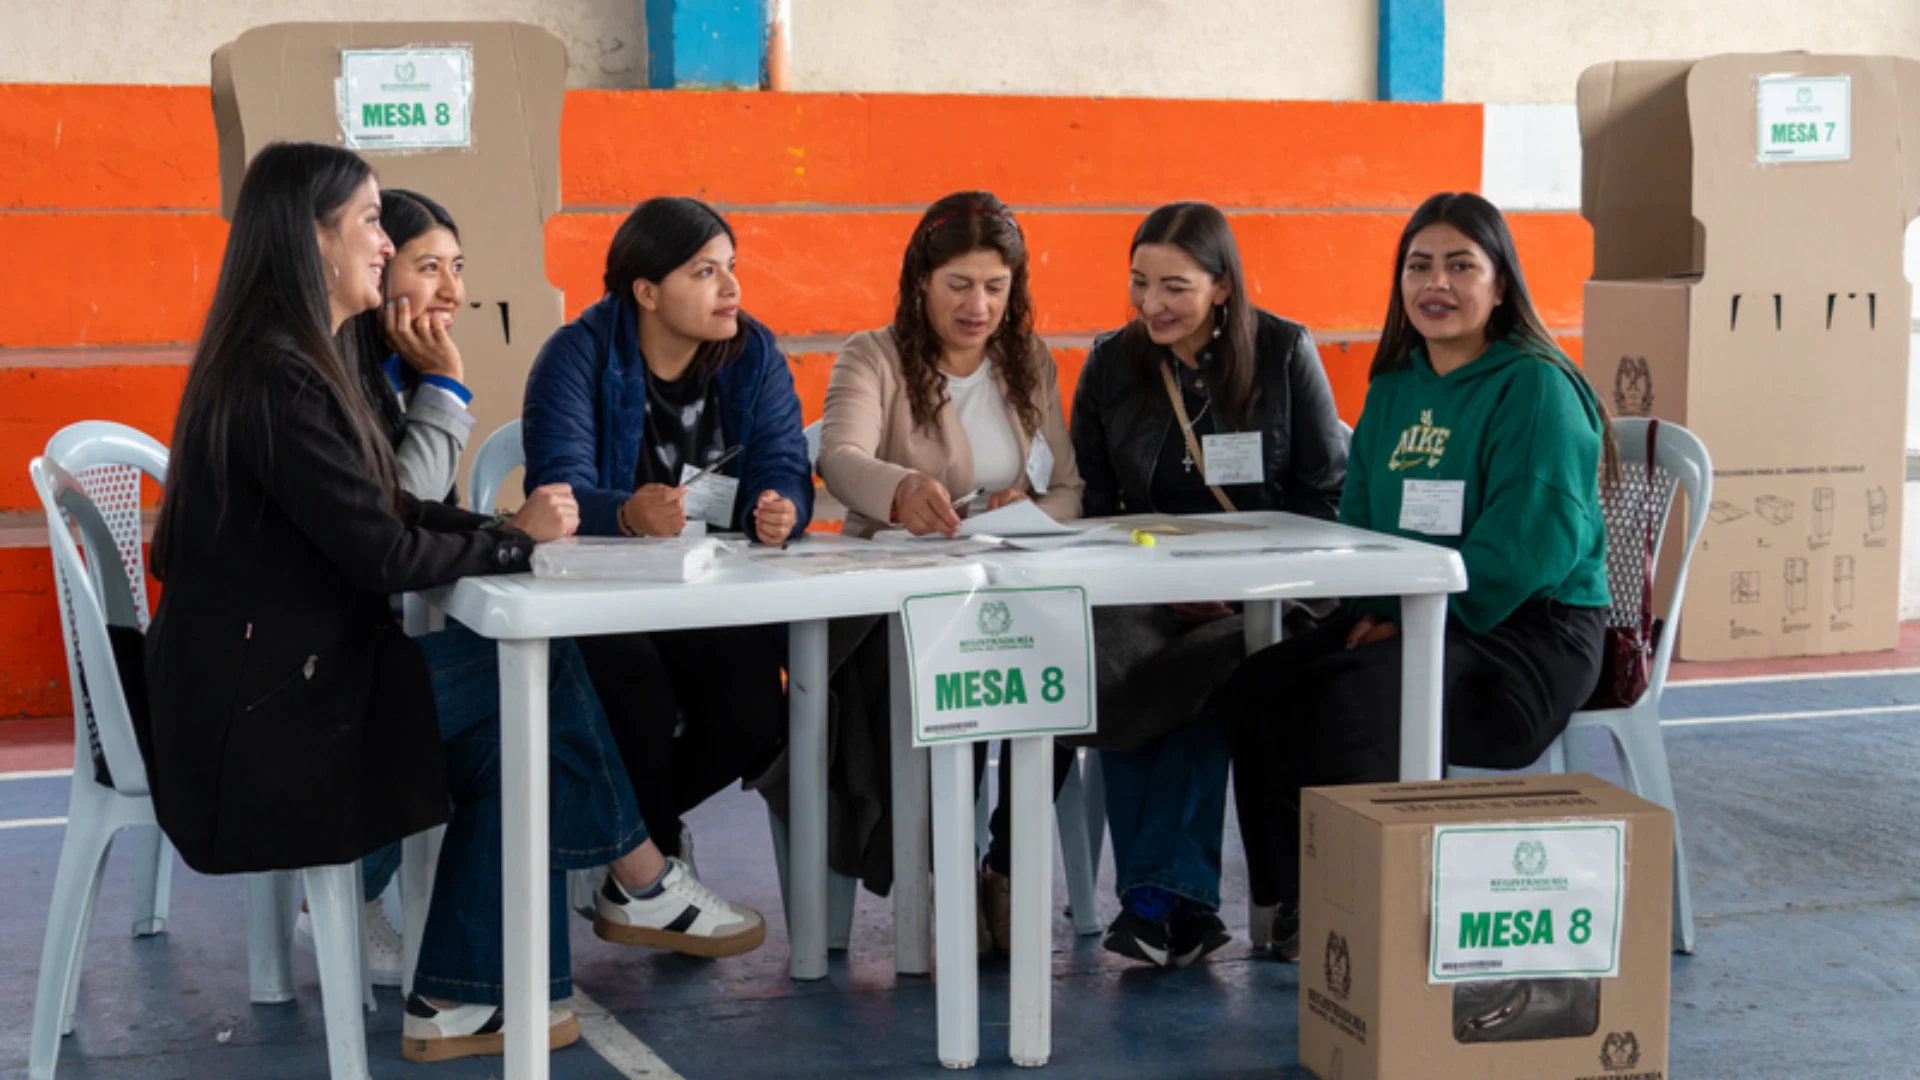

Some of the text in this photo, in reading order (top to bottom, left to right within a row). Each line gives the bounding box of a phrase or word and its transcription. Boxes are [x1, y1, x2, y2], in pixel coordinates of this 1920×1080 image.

[362, 102, 450, 128] MESA 8
[1771, 122, 1836, 143] MESA 7
[1392, 424, 1452, 457] NIKE
[935, 666, 1065, 711] MESA 8
[1458, 907, 1593, 949] MESA 8
